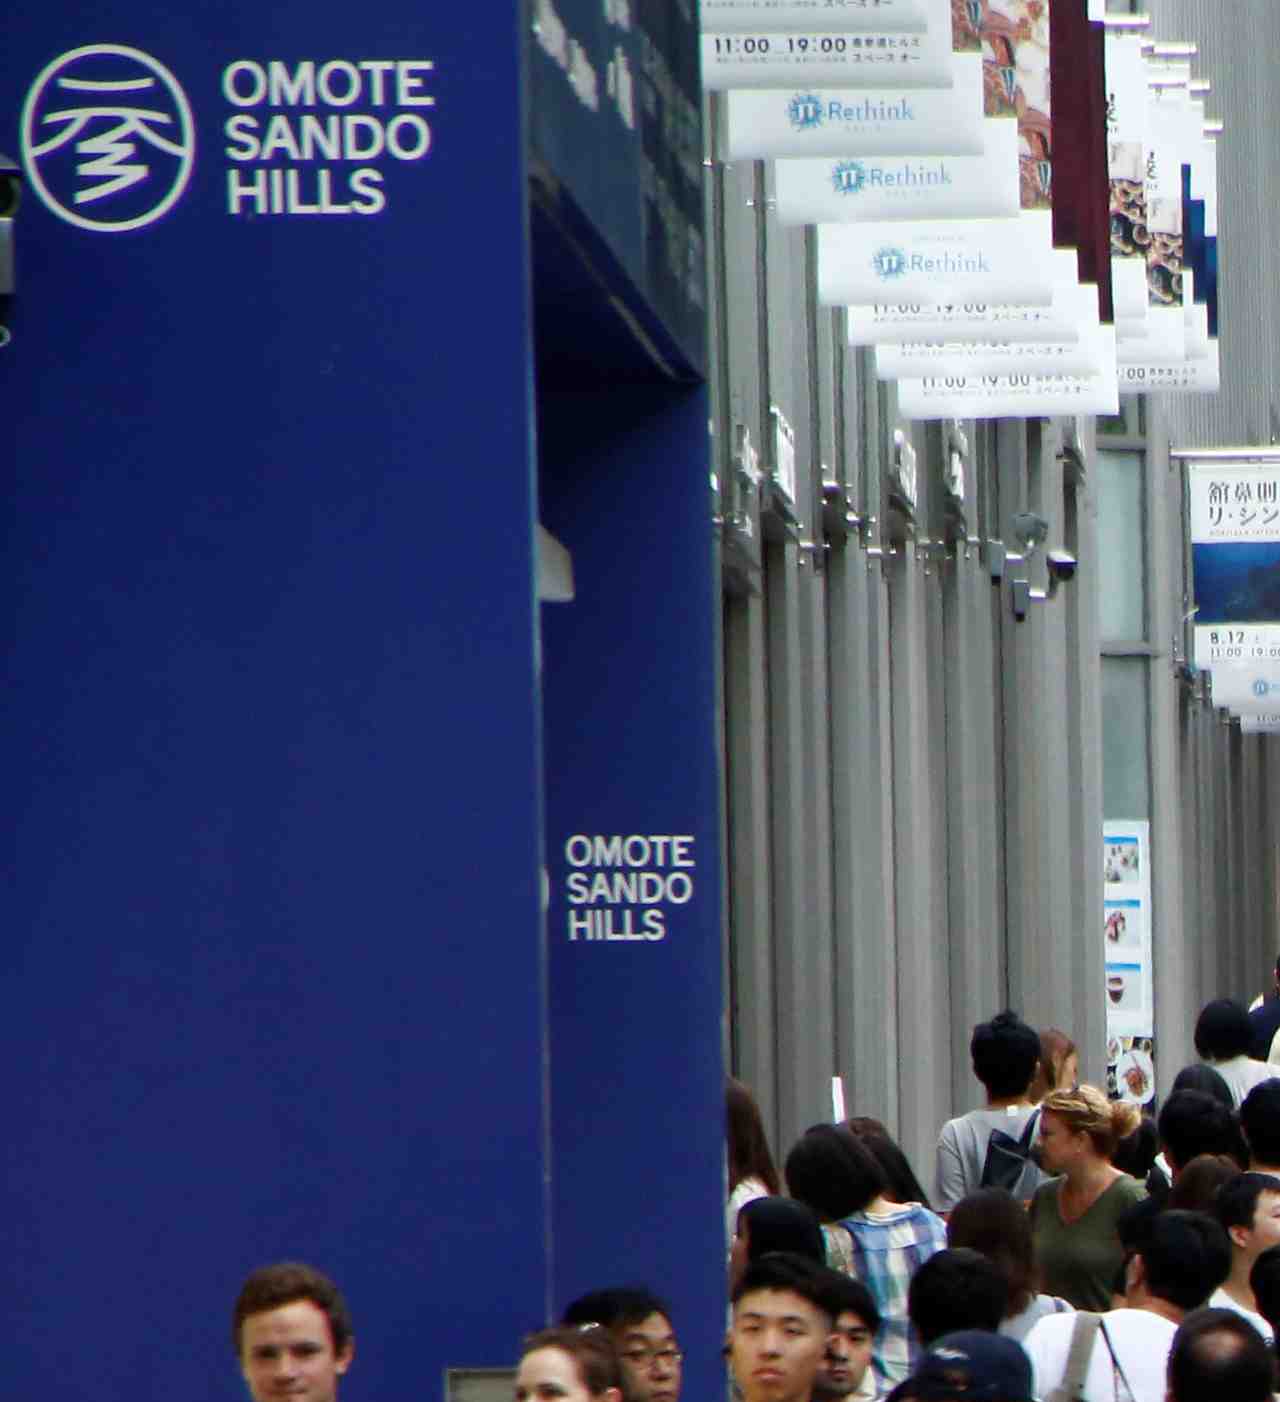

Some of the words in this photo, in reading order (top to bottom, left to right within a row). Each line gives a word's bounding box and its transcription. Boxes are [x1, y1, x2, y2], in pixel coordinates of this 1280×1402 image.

[714, 37, 770, 53] 11:00
[787, 37, 847, 53] 19:00
[222, 60, 434, 107] OMOTE
[828, 99, 914, 121] Rethink
[224, 114, 431, 160] SANDO
[869, 161, 952, 188] Rethink
[226, 168, 386, 215] HILLS
[910, 251, 991, 274] Rethink
[565, 834, 696, 867] OMOTE
[566, 872, 693, 904] SANDO
[568, 909, 666, 941] HILLS
